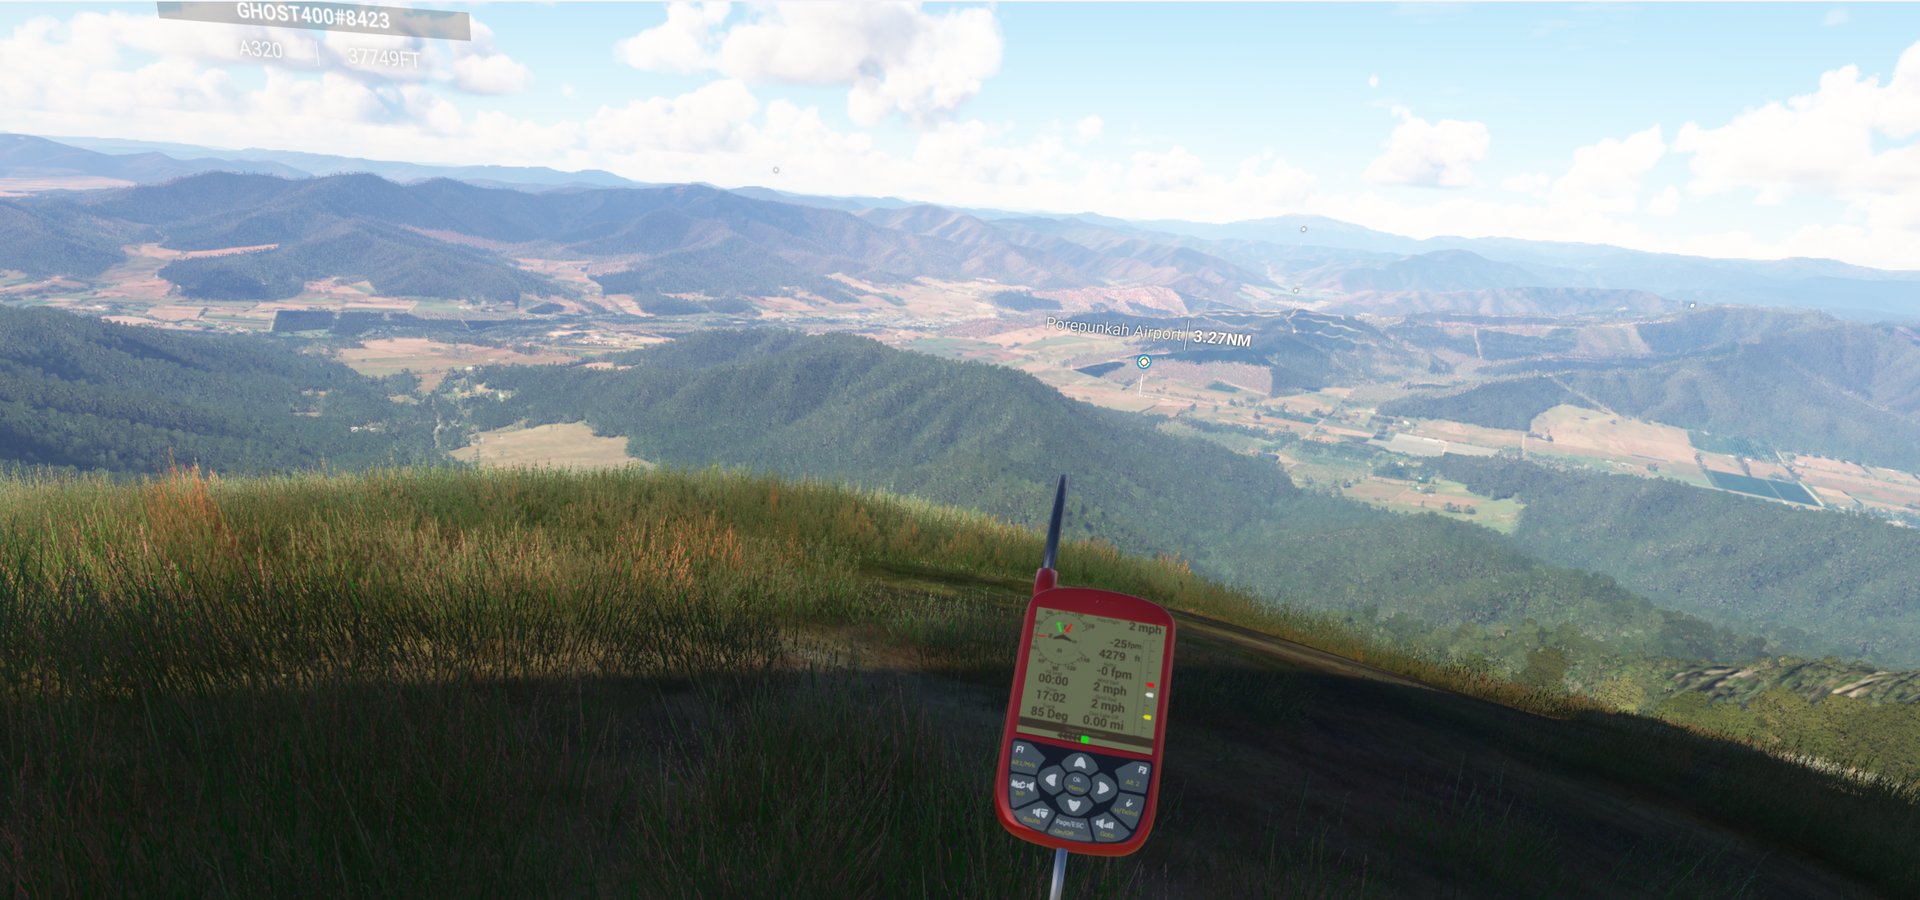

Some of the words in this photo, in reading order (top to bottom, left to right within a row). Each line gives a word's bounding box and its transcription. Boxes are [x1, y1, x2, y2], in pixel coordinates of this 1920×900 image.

[1128, 621, 1136, 632] 2
[1138, 624, 1162, 636] mph
[1098, 649, 1126, 661] 4279
[1038, 672, 1069, 687] 00:00
[1096, 666, 1108, 676] -0
[1111, 667, 1133, 680] fpm
[1036, 689, 1066, 704] 17:02
[1093, 682, 1101, 692] 2
[1103, 685, 1127, 697] mph
[1091, 698, 1098, 709] 2
[1100, 702, 1125, 714] mph
[1031, 706, 1045, 717] 85
[1047, 708, 1069, 723] Deg
[1082, 714, 1108, 728] 0.00
[1109, 720, 1124, 731] mi
